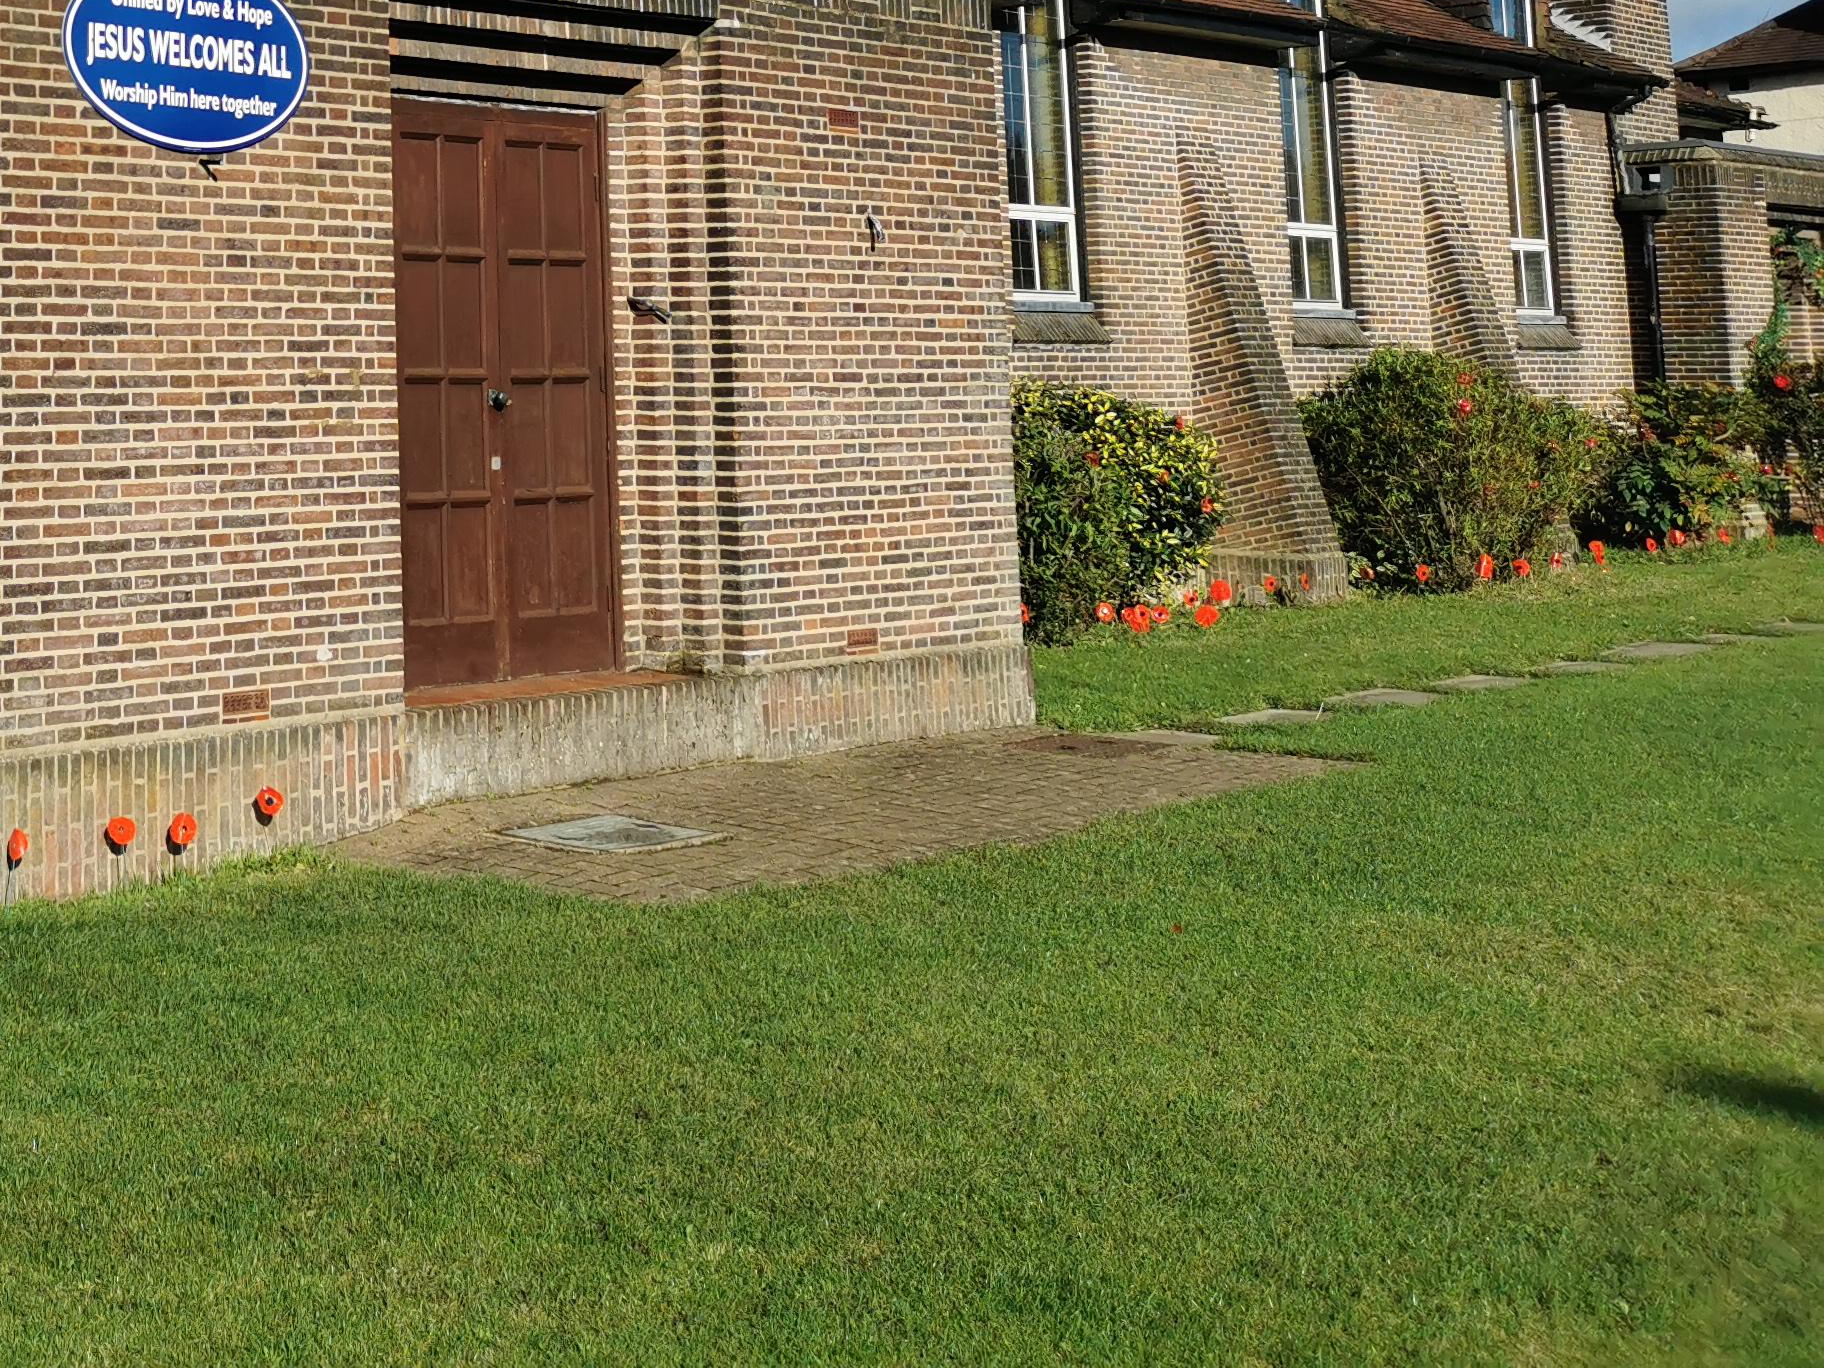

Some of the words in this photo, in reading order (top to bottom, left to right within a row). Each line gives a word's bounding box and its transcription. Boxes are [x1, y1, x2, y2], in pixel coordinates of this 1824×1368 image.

[237, 0, 273, 30] Hope
[86, 21, 145, 66] JESUS
[148, 28, 255, 75] WELCOMES
[257, 43, 292, 79] ALL
[100, 78, 157, 110] Worship
[159, 84, 188, 108] Him
[190, 87, 220, 111] here
[221, 94, 277, 119] together
